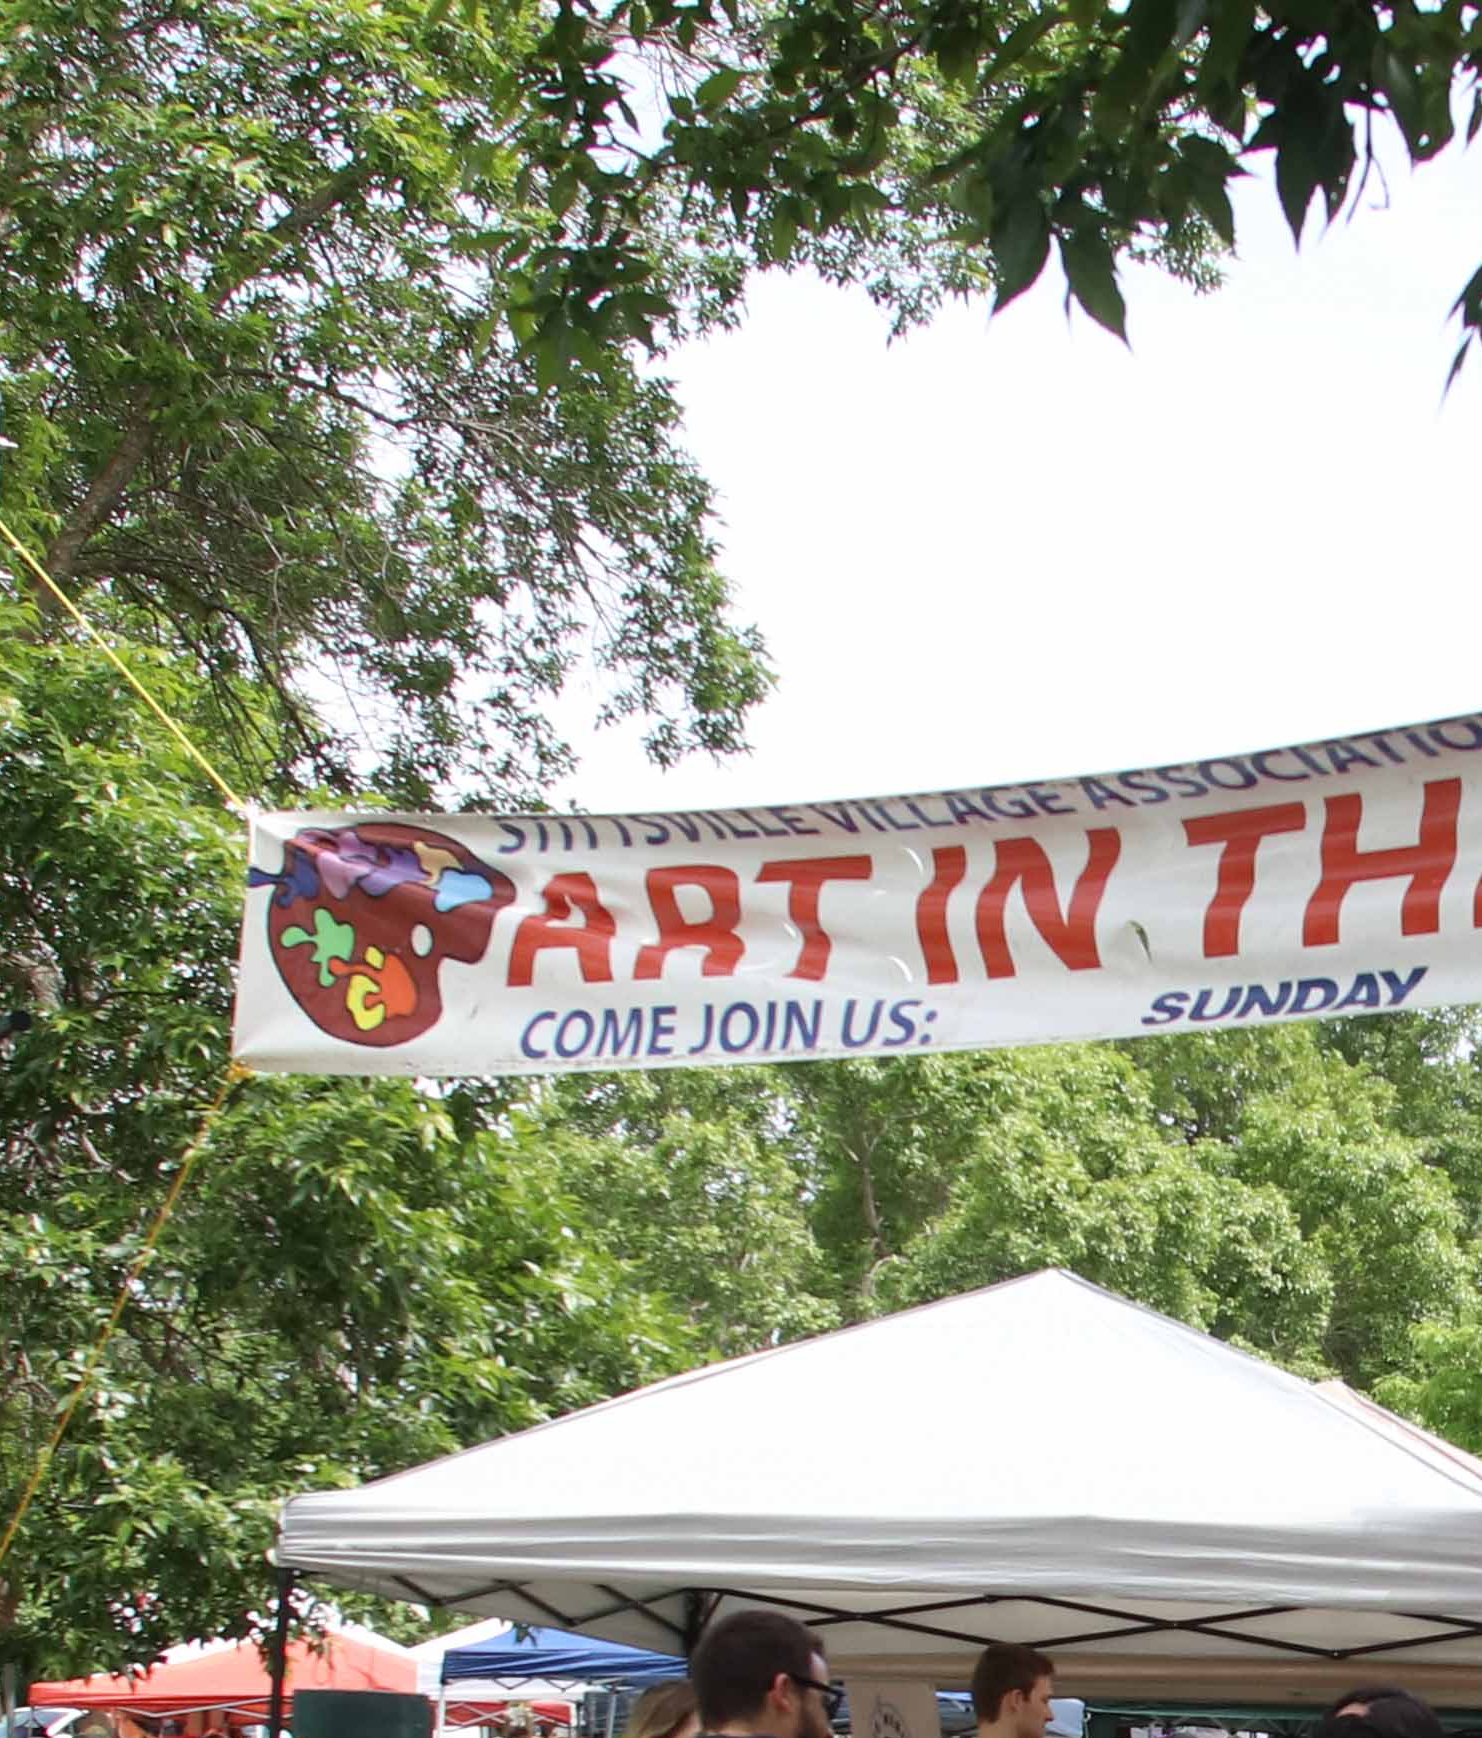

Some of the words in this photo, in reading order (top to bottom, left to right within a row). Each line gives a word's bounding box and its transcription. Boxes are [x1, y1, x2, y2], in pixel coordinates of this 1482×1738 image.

[806, 780, 1078, 833] VILLAGE
[506, 855, 872, 986] ART
[916, 826, 1122, 986] IN
[1142, 966, 1428, 1025] SUNDAY
[520, 1006, 676, 1058] COME
[689, 1000, 822, 1054] JOIN
[840, 998, 938, 1046] US:
